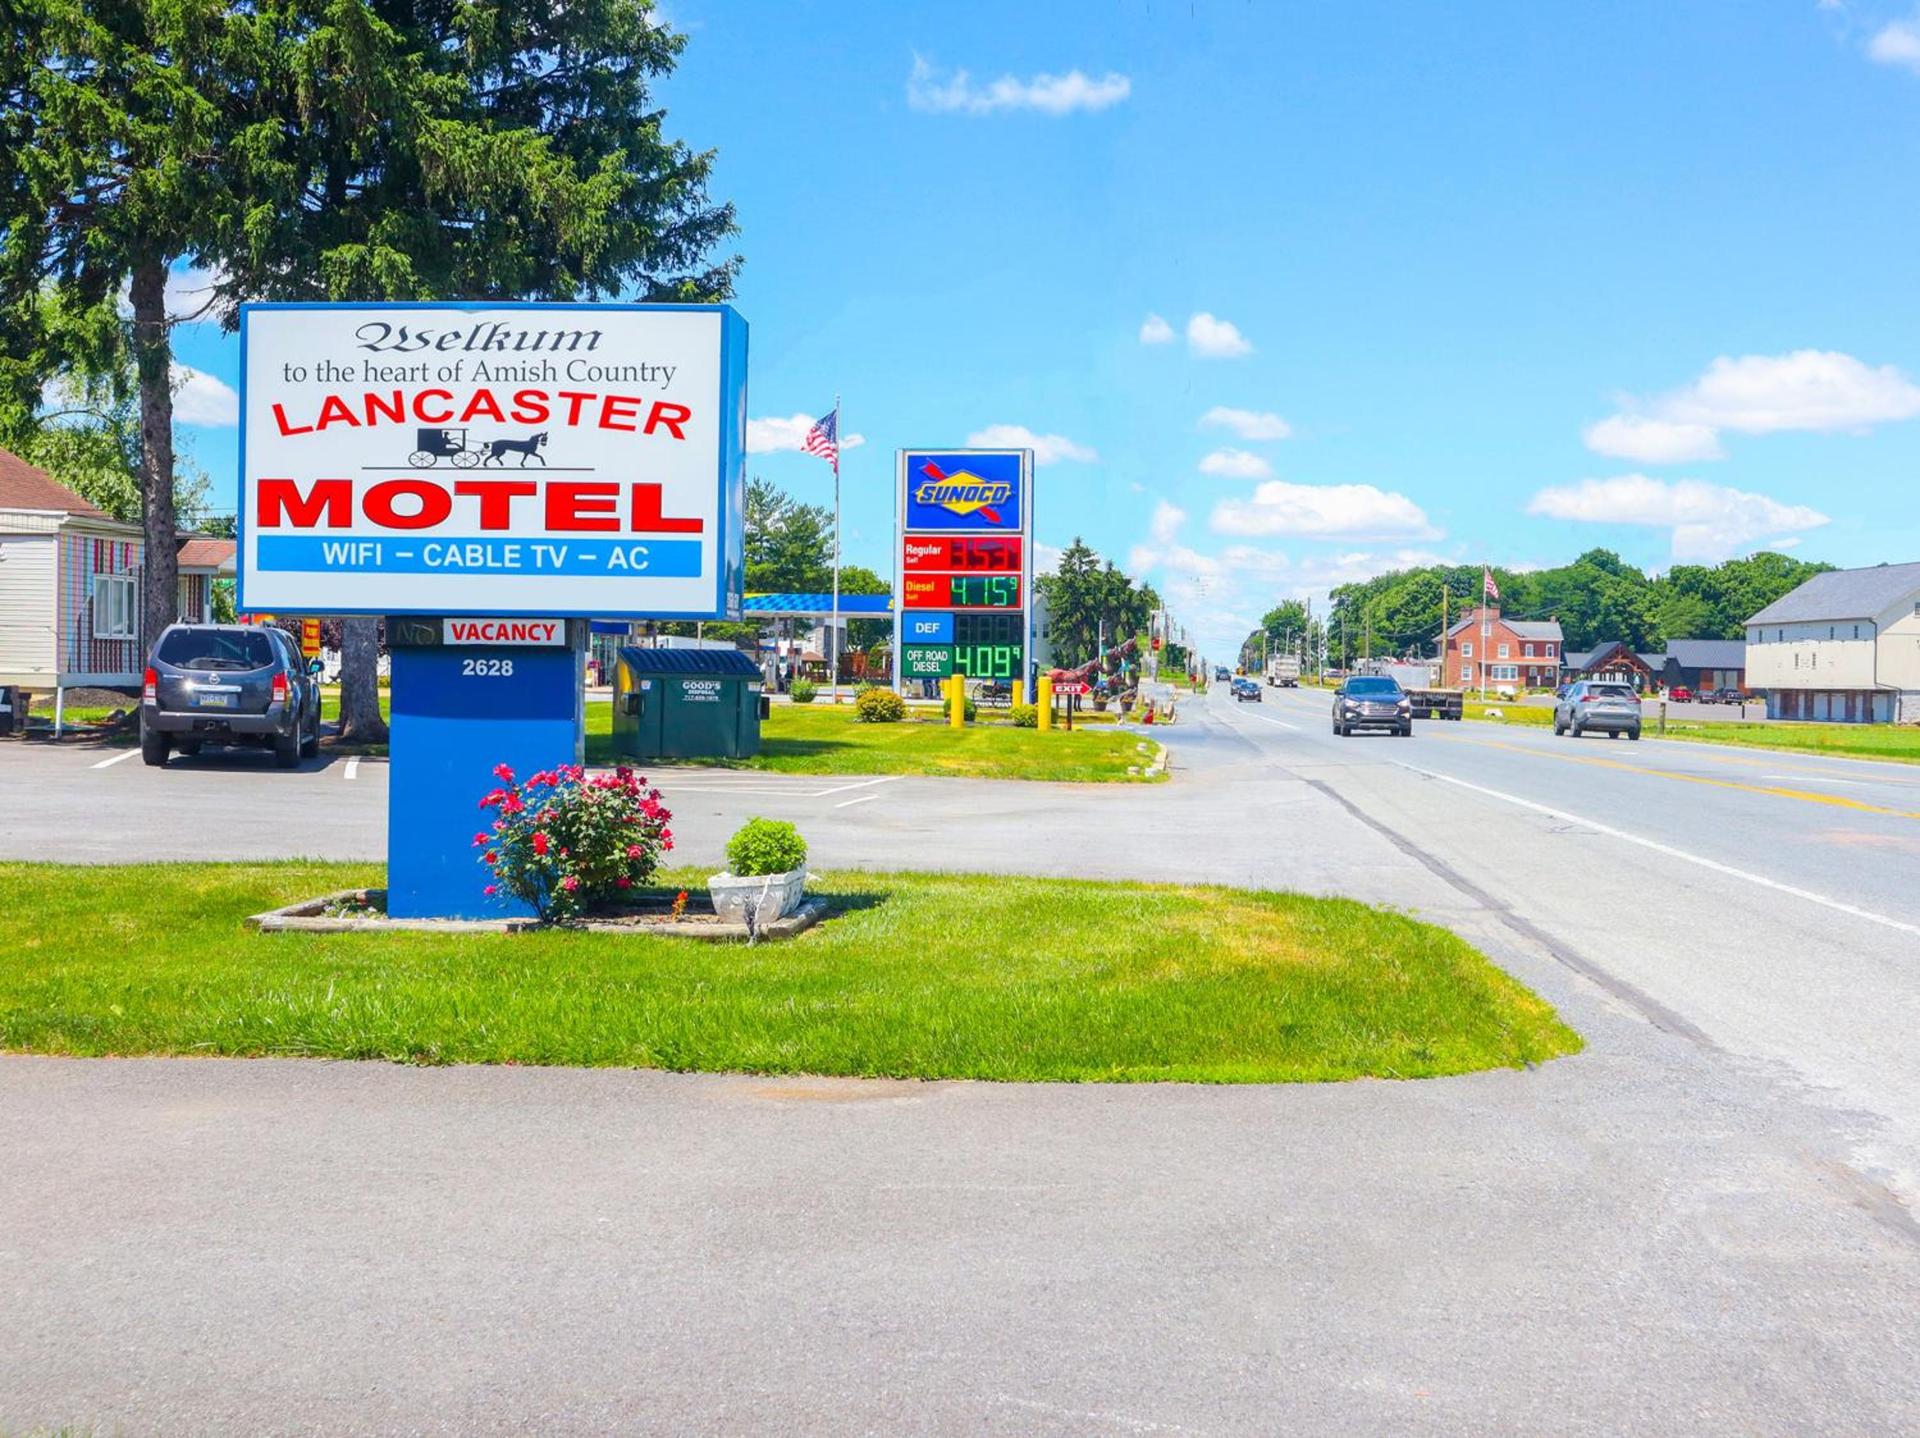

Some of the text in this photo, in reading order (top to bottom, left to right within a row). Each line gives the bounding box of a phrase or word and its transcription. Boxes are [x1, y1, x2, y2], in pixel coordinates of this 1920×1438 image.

[355, 321, 603, 351] Welkum
[283, 359, 677, 390] to the heart of Amish Country
[271, 388, 692, 440] LANCASTER
[921, 485, 1008, 502] SUNOCO
[257, 479, 704, 534] MOTEL
[323, 542, 382, 567] WIFI
[423, 543, 521, 569] CABLE
[531, 545, 568, 568] TV
[606, 547, 650, 571] AC
[906, 544, 942, 557] Regular
[906, 581, 935, 592] Diesel
[451, 623, 556, 641] VACANCY
[915, 622, 941, 634] DEF
[907, 650, 924, 661] OFF
[925, 650, 949, 661] ROAD
[462, 659, 514, 676] 2628
[913, 661, 942, 672] DIESEL
[682, 681, 721, 690] GOOD'S
